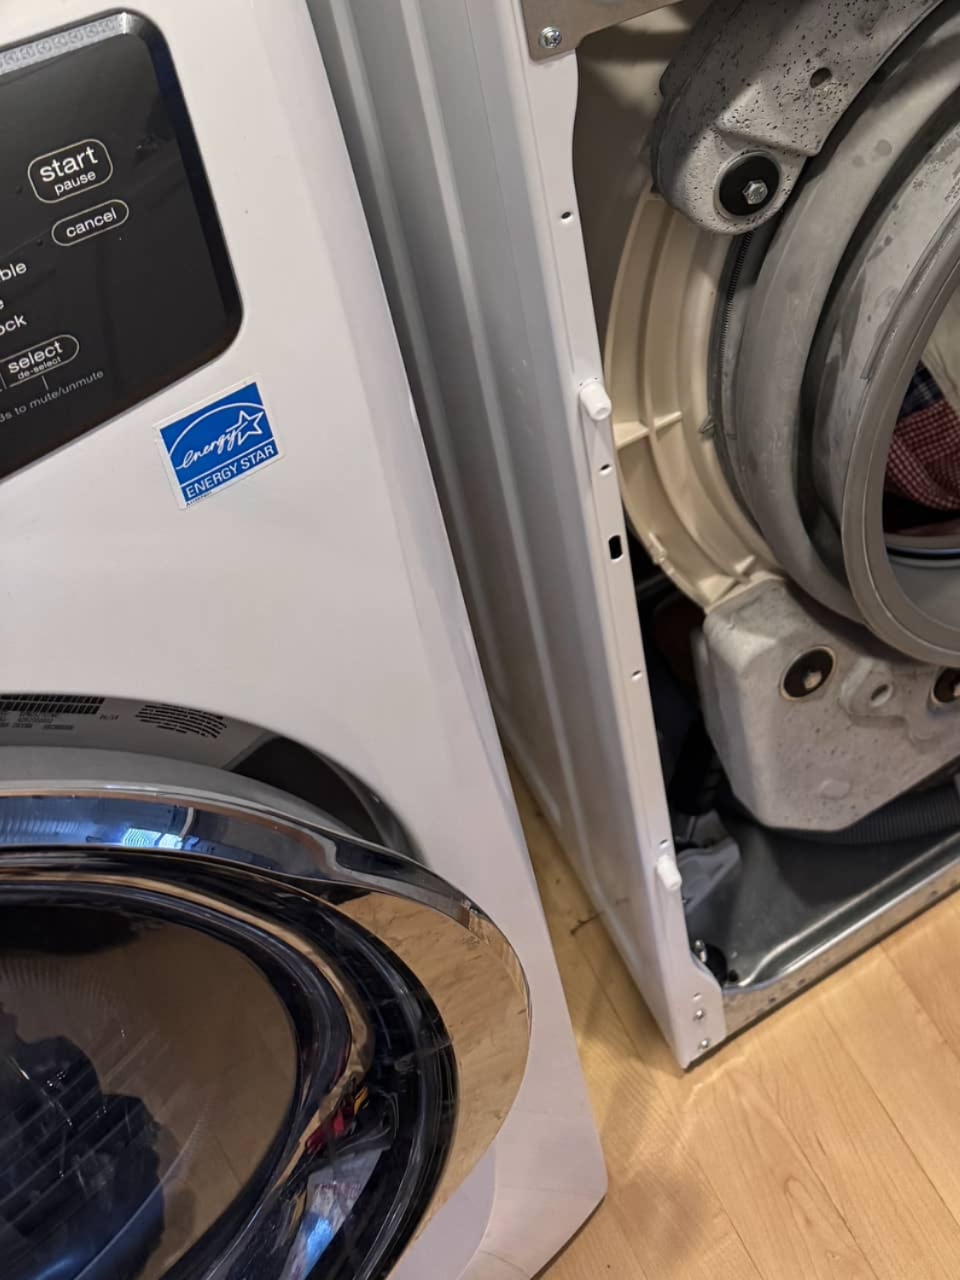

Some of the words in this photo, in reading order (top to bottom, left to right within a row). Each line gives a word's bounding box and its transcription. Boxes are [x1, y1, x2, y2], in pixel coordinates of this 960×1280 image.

[40, 146, 98, 182] start
[54, 171, 96, 196] pause
[66, 207, 117, 237] cancel
[8, 340, 63, 373] select
[17, 356, 61, 380] de-select
[14, 405, 27, 415] to
[29, 370, 104, 408] mute/unmute
[185, 462, 238, 498] ENERGY
[241, 444, 275, 469] STAR
